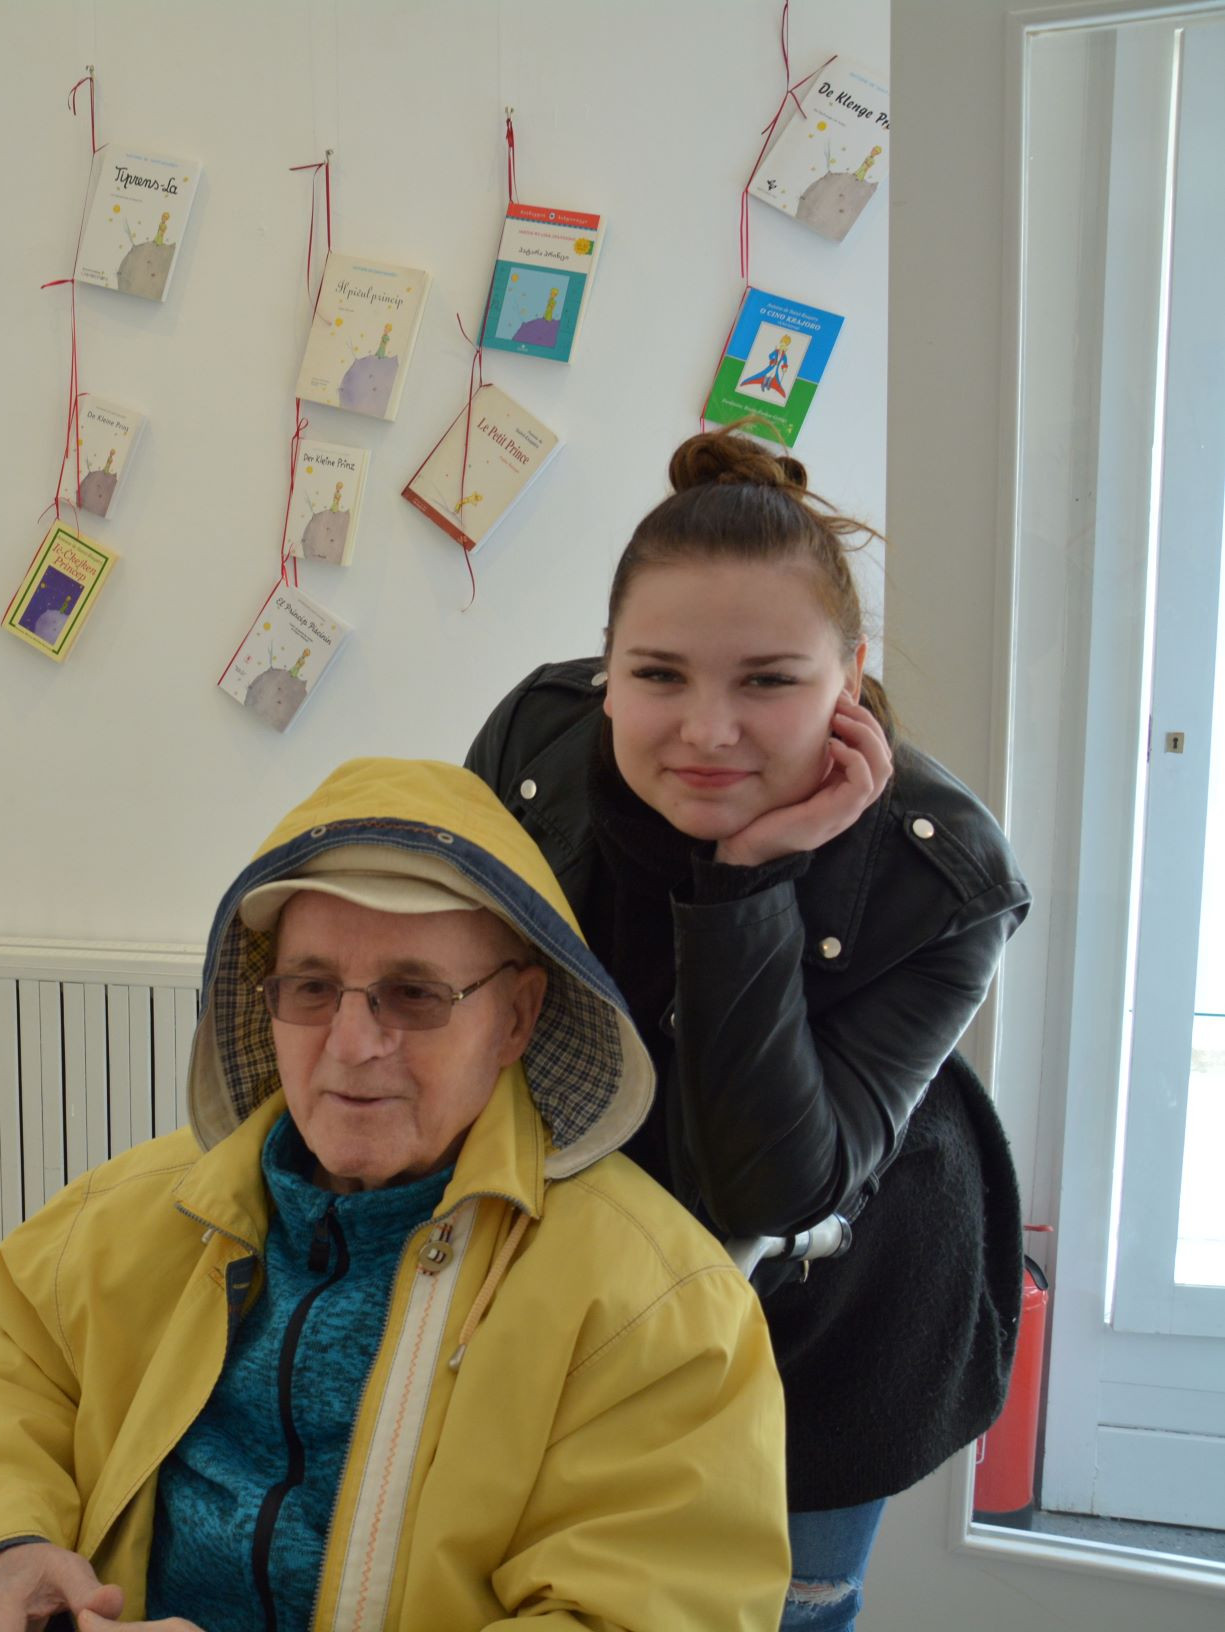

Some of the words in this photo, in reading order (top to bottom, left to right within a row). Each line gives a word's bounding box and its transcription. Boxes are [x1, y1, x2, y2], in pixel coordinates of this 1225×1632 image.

[818, 82, 834, 98] De
[836, 91, 874, 119] Klenge
[476, 417, 489, 433] Le
[488, 426, 508, 446] Petit
[505, 438, 530, 465] Prince
